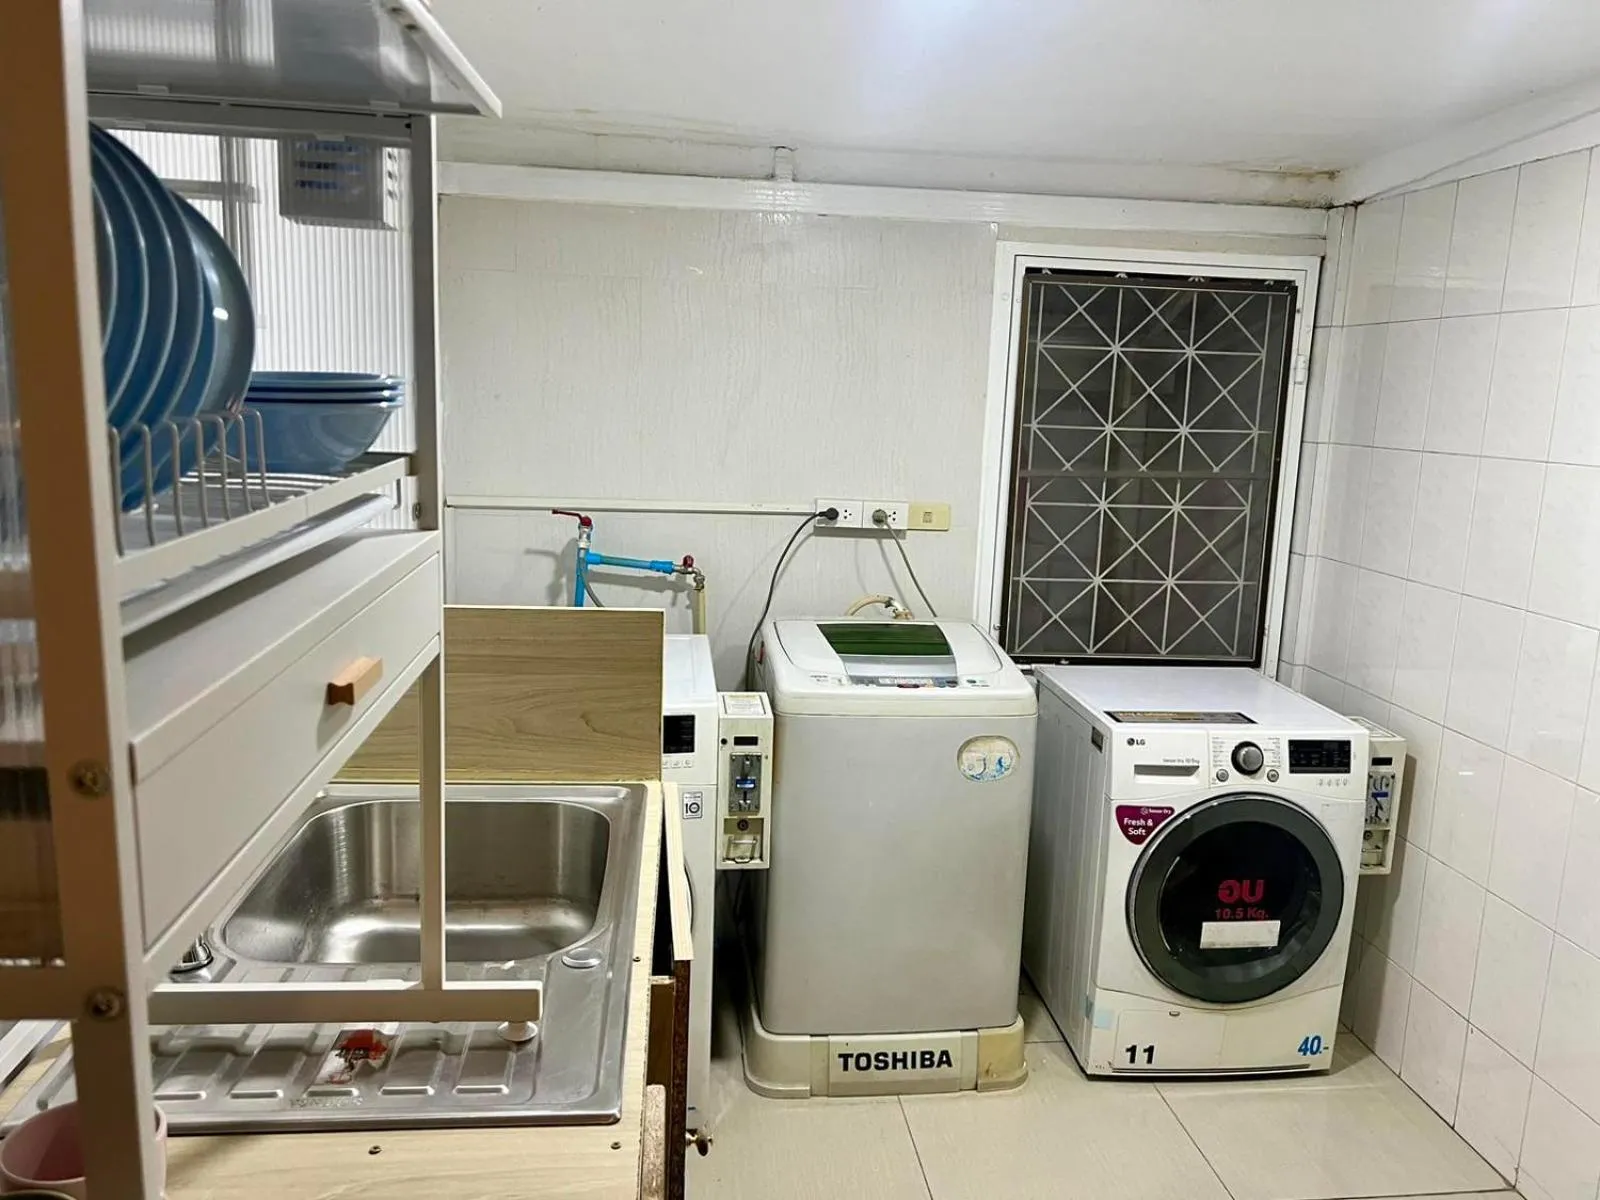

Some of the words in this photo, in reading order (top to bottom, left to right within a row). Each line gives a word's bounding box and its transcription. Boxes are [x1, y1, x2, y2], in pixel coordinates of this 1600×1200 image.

[1123, 817, 1146, 826] Fresh
[1146, 818, 1153, 826] &
[1128, 827, 1147, 835] Soft
[1215, 907, 1244, 920] 10.5
[837, 1050, 954, 1072] TOSHIBA
